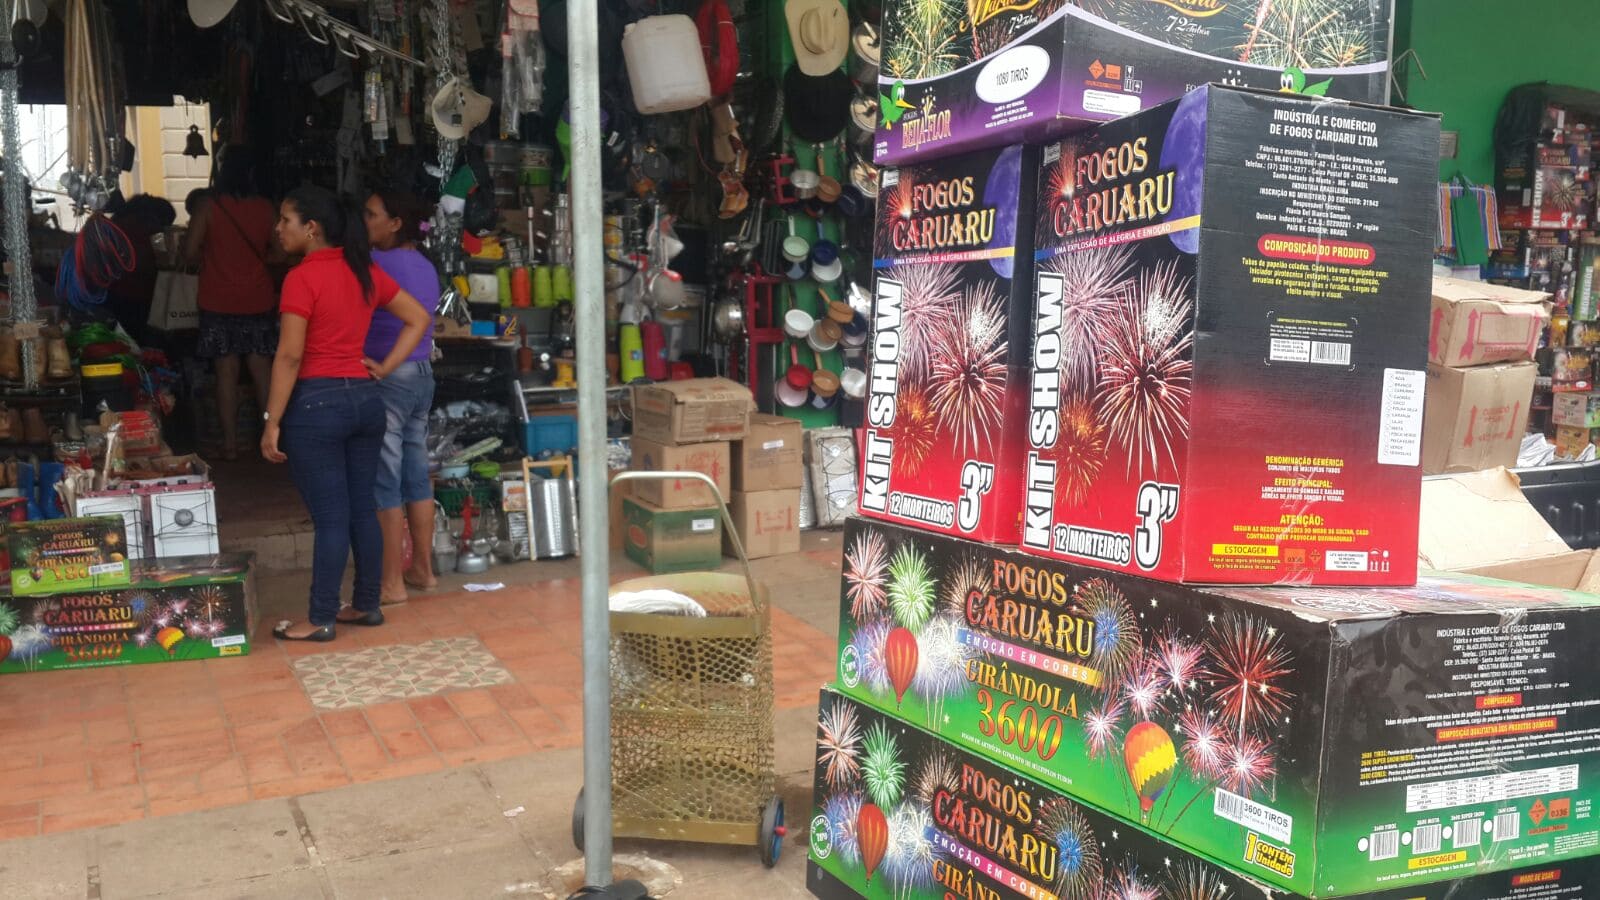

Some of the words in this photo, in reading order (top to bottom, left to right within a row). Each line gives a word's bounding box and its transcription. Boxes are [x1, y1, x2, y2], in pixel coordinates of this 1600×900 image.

[1165, 15, 1188, 32] 72
[1010, 67, 1029, 83] TIROS
[1270, 123, 1281, 135] DE
[1284, 125, 1312, 139] FOGOS
[1315, 128, 1355, 145] CARUARU
[1358, 134, 1378, 148] LTDA
[1274, 108, 1320, 126] INDÚSTRIA
[1323, 115, 1328, 127] E
[1331, 116, 1377, 133] COMÉRCIO
[1076, 136, 1149, 189] FOGOS
[912, 176, 974, 212] FOGOS
[1534, 169, 1543, 206] SHOW
[1054, 171, 1176, 237] CARUARU
[893, 208, 996, 251] CARUARU
[1055, 245, 1067, 255] UMA
[1067, 239, 1098, 252] EXPLOSÃO
[1099, 237, 1107, 245] DE
[1108, 233, 1135, 245] ALEGRIA
[1137, 231, 1141, 239] E
[1143, 224, 1171, 237] EMOÇÃO
[1264, 239, 1317, 256] COMPOSIÇÃO
[1319, 245, 1330, 256] DO
[1332, 247, 1369, 260] PRODUTO
[869, 278, 903, 427] SHOW
[1030, 272, 1065, 447] SHOW
[862, 431, 895, 513] KIT
[1265, 455, 1312, 467] DENOMINAÇÃO
[1312, 457, 1344, 467] GENÉRICA
[1275, 478, 1296, 487] EFEITO
[1297, 479, 1333, 488] PRINCIPAL:
[890, 494, 903, 513] 12
[902, 496, 954, 527] MORTEIROS
[1022, 452, 1057, 549] KIT
[53, 531, 84, 540] FOGOS
[1280, 514, 1324, 527] ATENÇÃO:
[43, 539, 94, 550] CARUARU
[1054, 527, 1068, 550] 12
[1069, 528, 1131, 563] MORTEIROS
[1224, 546, 1267, 554] ESTOCAGEM
[992, 559, 1068, 606] FOGOS
[44, 606, 132, 625] CARUARU
[63, 594, 113, 608] FOGOS
[51, 632, 129, 646] GIRÂNDOLA
[966, 590, 1094, 658] CARUARU
[1437, 628, 1465, 637] INDÚSTRIA
[1467, 628, 1471, 636] E
[1471, 626, 1499, 635] COMÉRCIO
[1511, 625, 1528, 633] FOGOS
[1529, 623, 1552, 632] CARUARU
[1553, 622, 1565, 630] LTDA
[63, 641, 123, 662] 3600
[966, 633, 1015, 658] EMOÇÃO
[1020, 652, 1037, 664] EM
[1042, 658, 1088, 681] CORES
[965, 658, 1079, 719] GIRÂNDOLA
[1471, 678, 1505, 688] RESPONSÁVEL
[977, 688, 1063, 761] 3600
[960, 762, 1032, 824] FOGOS
[1244, 803, 1262, 816] 3600
[1264, 810, 1288, 827] TIROS
[934, 790, 1056, 881] CARUARU
[1246, 833, 1257, 861] 1
[1257, 841, 1293, 864] CONTÉM
[933, 833, 981, 868] EMOÇÃO
[986, 863, 1002, 880] EM
[1256, 852, 1293, 876] Unidade
[1418, 854, 1457, 866] ESTOCAGEM
[932, 859, 1001, 900] GIRÂND
